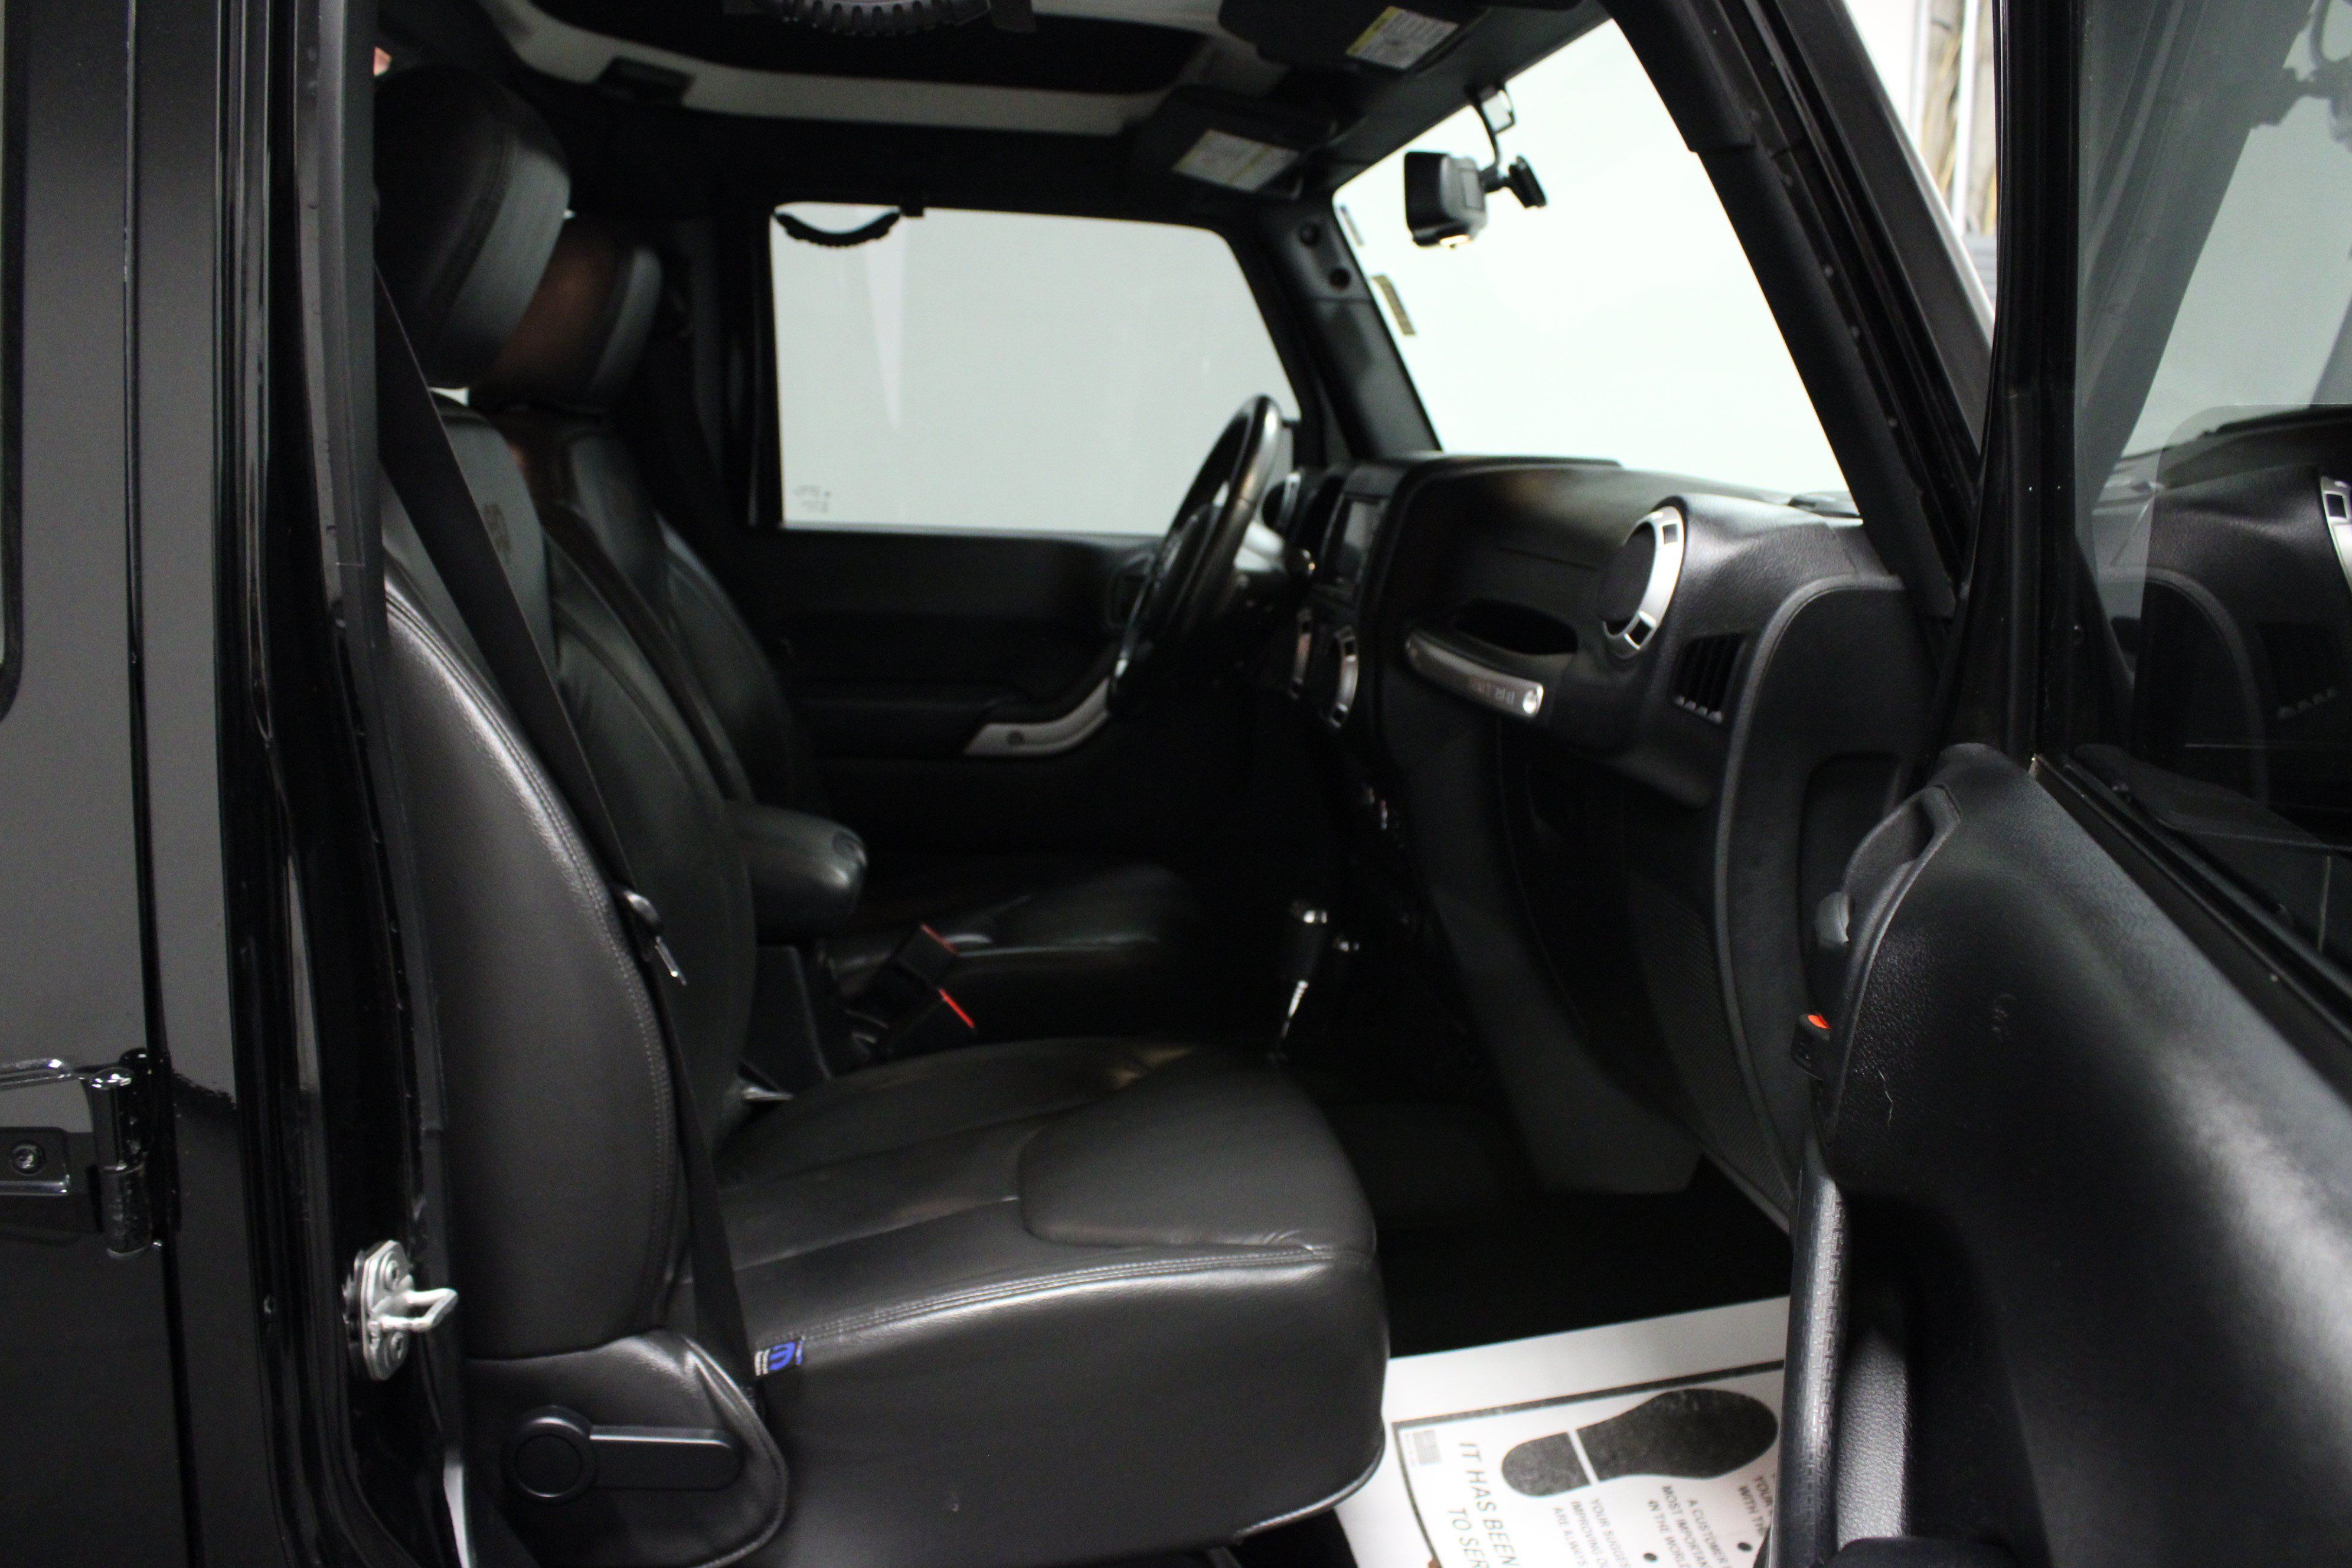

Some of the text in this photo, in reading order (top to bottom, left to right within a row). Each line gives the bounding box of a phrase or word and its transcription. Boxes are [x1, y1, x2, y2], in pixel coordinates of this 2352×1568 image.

[1459, 1442, 1521, 1567] IT HAS BEEN
[1591, 1497, 1611, 1527] YOUR
[1661, 1484, 1683, 1515] MOST
[1448, 1507, 1472, 1531] TO
[1553, 1507, 1569, 1527] ARE
[1571, 1500, 1604, 1555] IMPROVING
[1692, 1508, 1729, 1563] CUSTOMER
